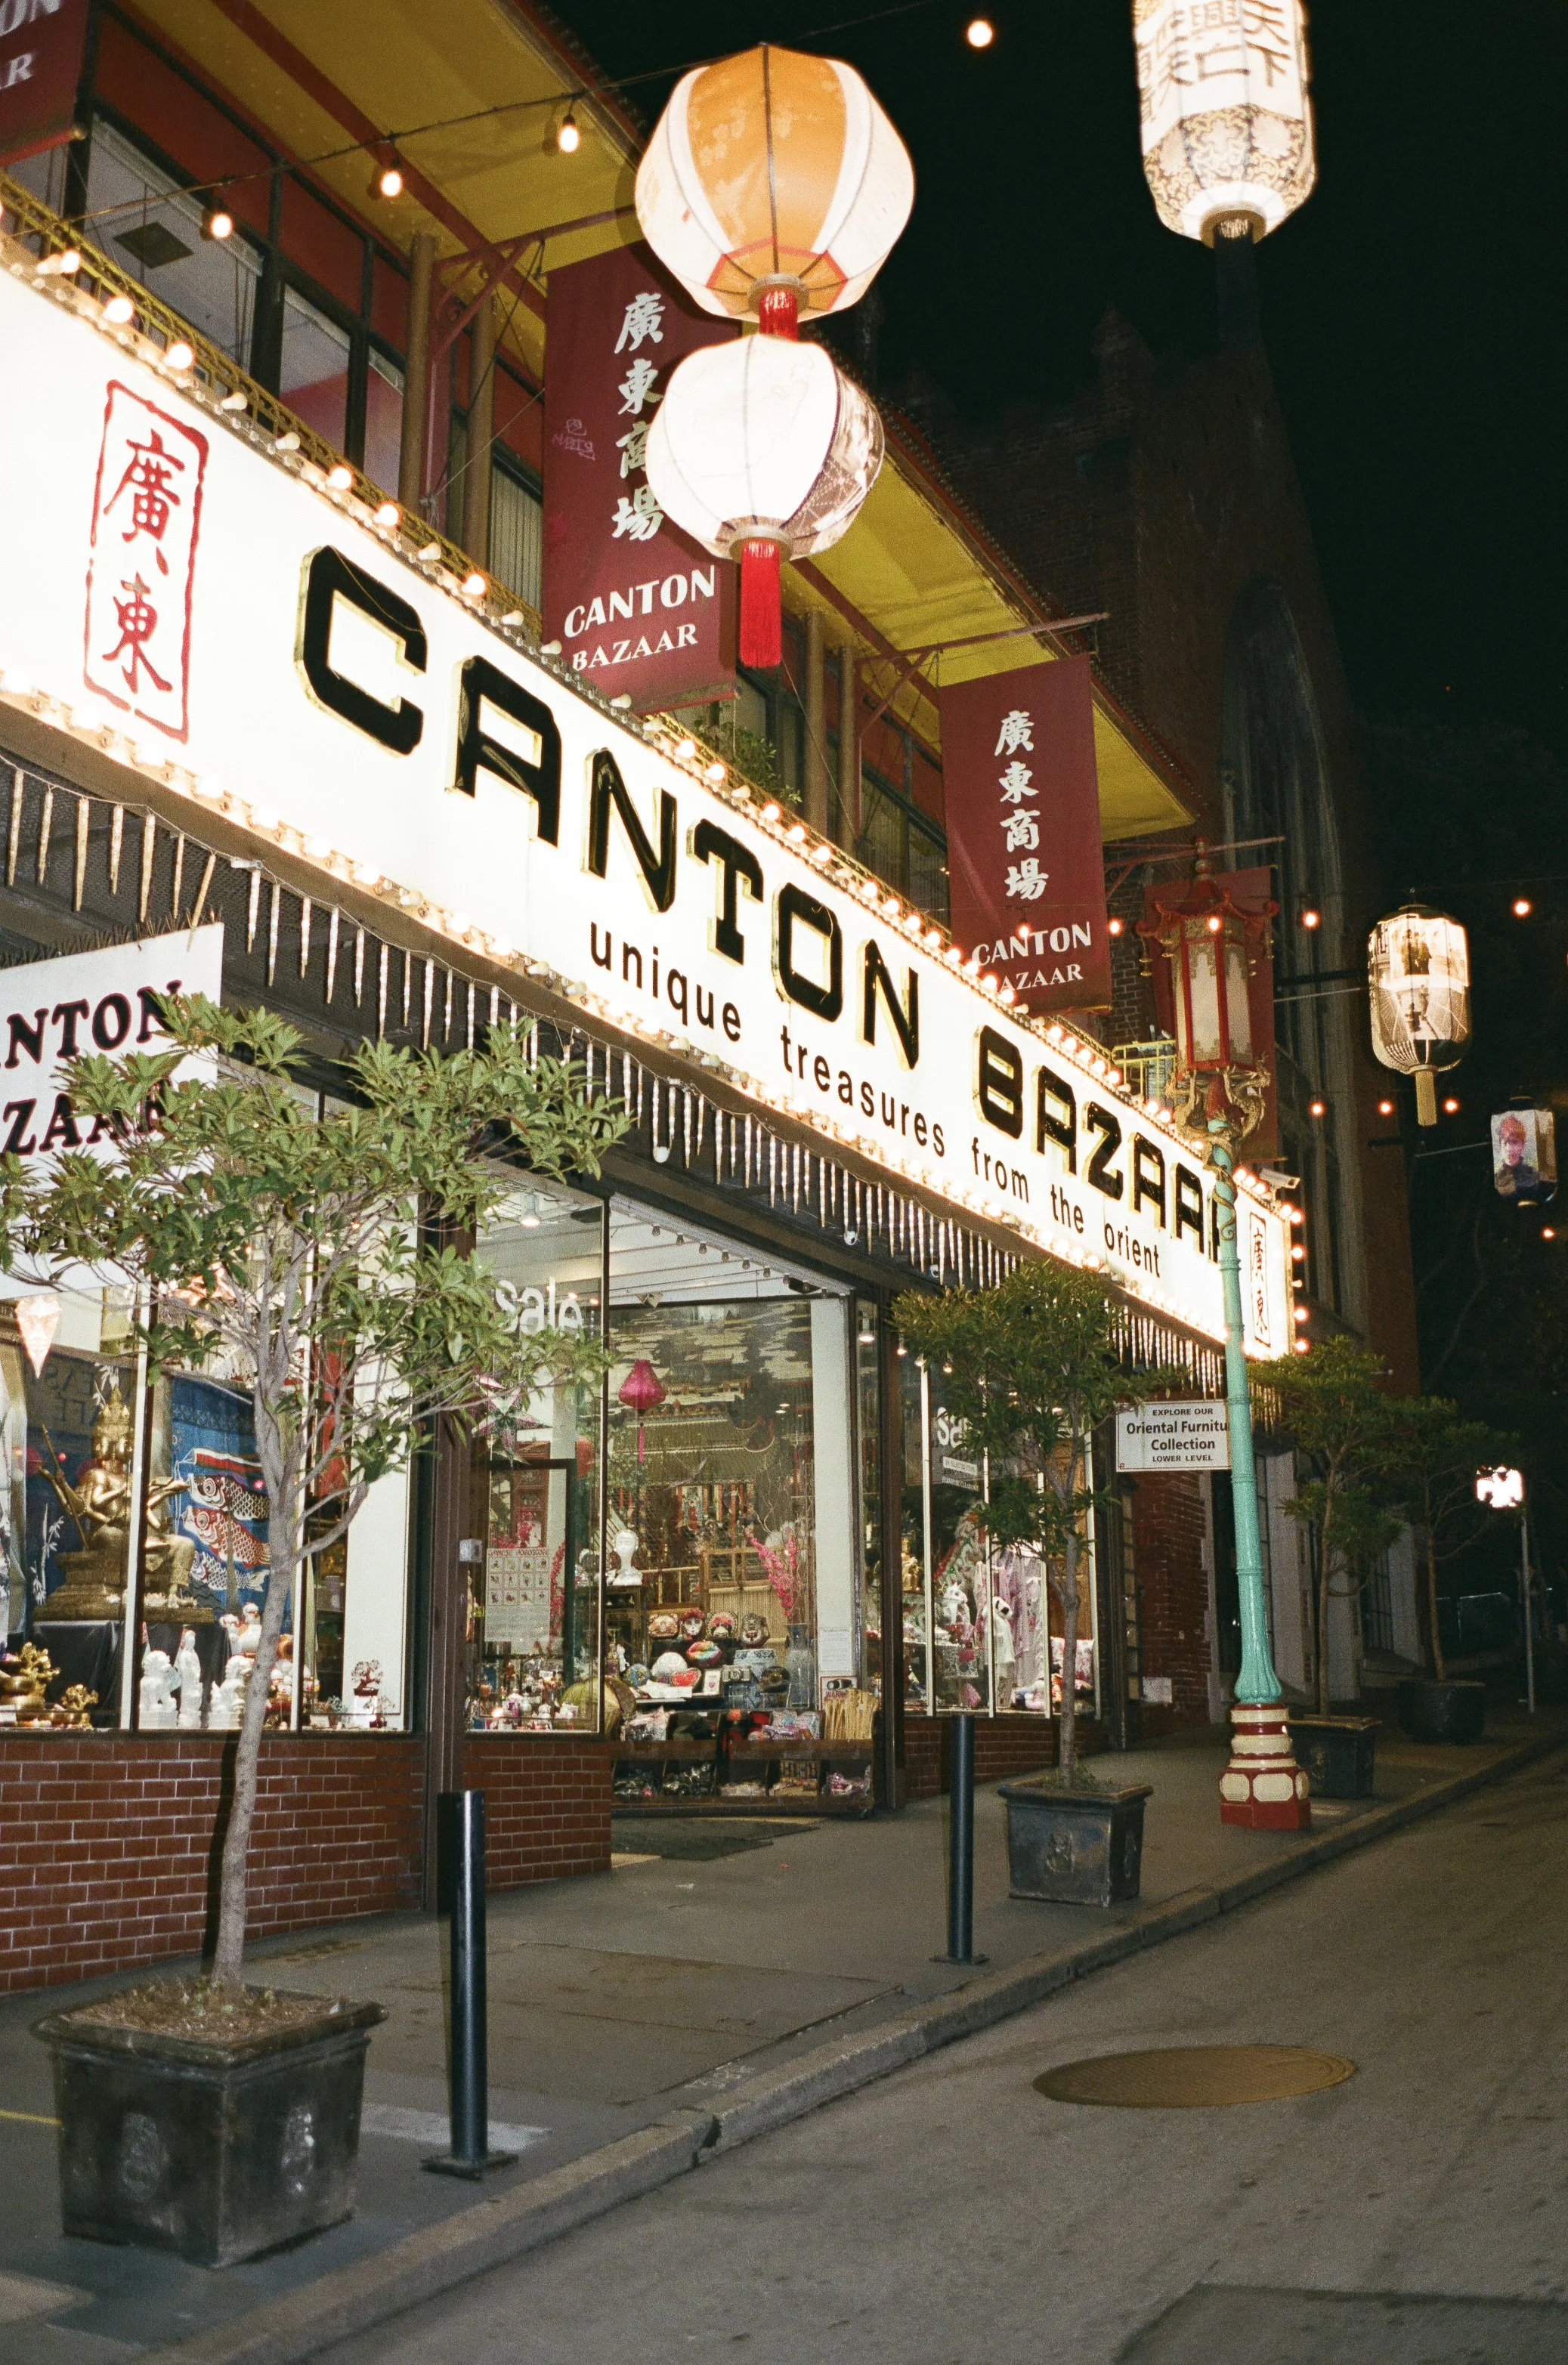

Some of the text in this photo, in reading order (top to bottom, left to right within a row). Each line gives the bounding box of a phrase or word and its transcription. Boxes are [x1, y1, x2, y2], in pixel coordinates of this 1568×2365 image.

[102, 428, 185, 694] 廣東
[564, 564, 716, 638] CANTON
[571, 623, 698, 672] BAZAAR
[994, 710, 1049, 900] 廣東商場
[294, 545, 1220, 1264] CANTON BAZAA
[972, 920, 1092, 966] CANTON
[998, 963, 1084, 994] AZAAR
[590, 922, 1161, 1278] unique treasures from the orient
[1127, 1420, 1229, 1434] Oriental Furnitu
[1151, 1438, 1215, 1451] Collection
